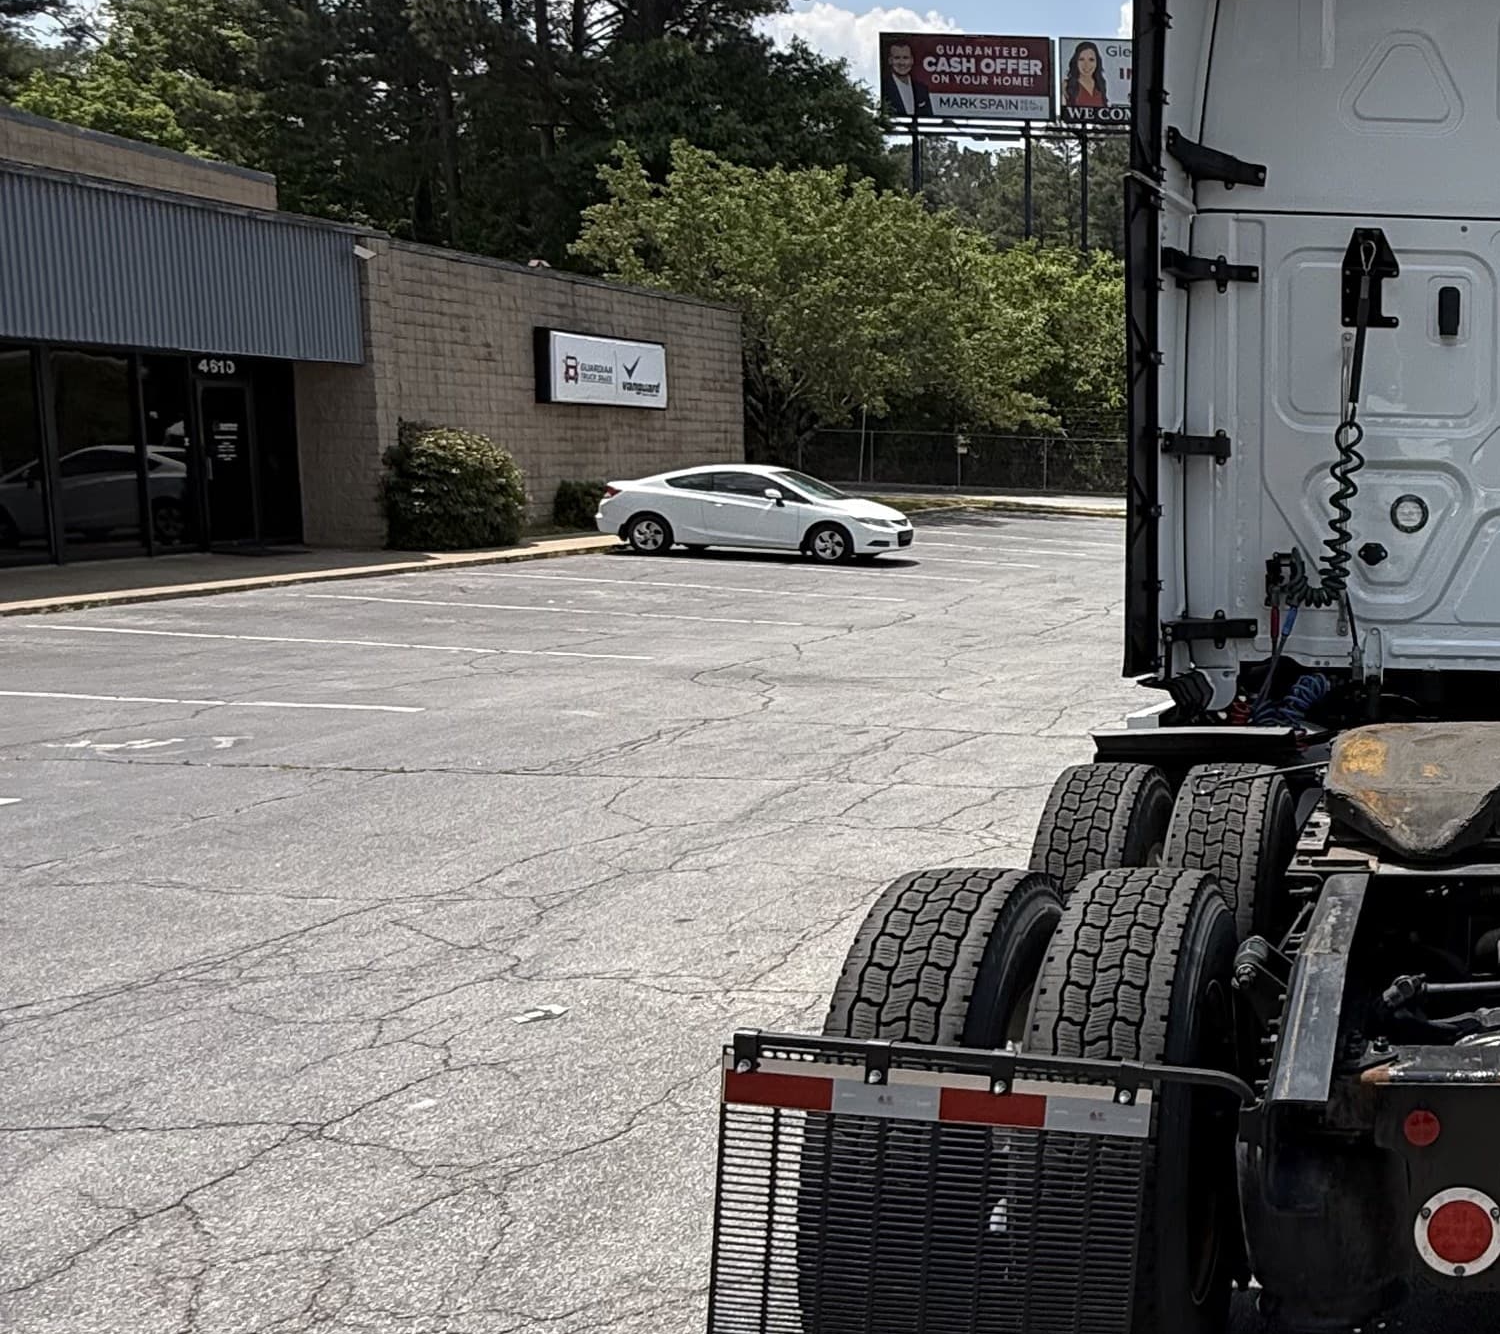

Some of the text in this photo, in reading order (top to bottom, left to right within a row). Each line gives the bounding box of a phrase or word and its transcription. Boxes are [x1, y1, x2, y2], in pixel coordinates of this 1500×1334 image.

[936, 45, 1029, 57] GUARANTEED
[923, 56, 1042, 75] CASH OFFER
[931, 74, 1034, 87] ON YOUR HOME!
[940, 97, 977, 109] MARK
[979, 99, 1019, 111] SPAIN
[1067, 107, 1094, 120] WE
[622, 381, 660, 395] vanguard
